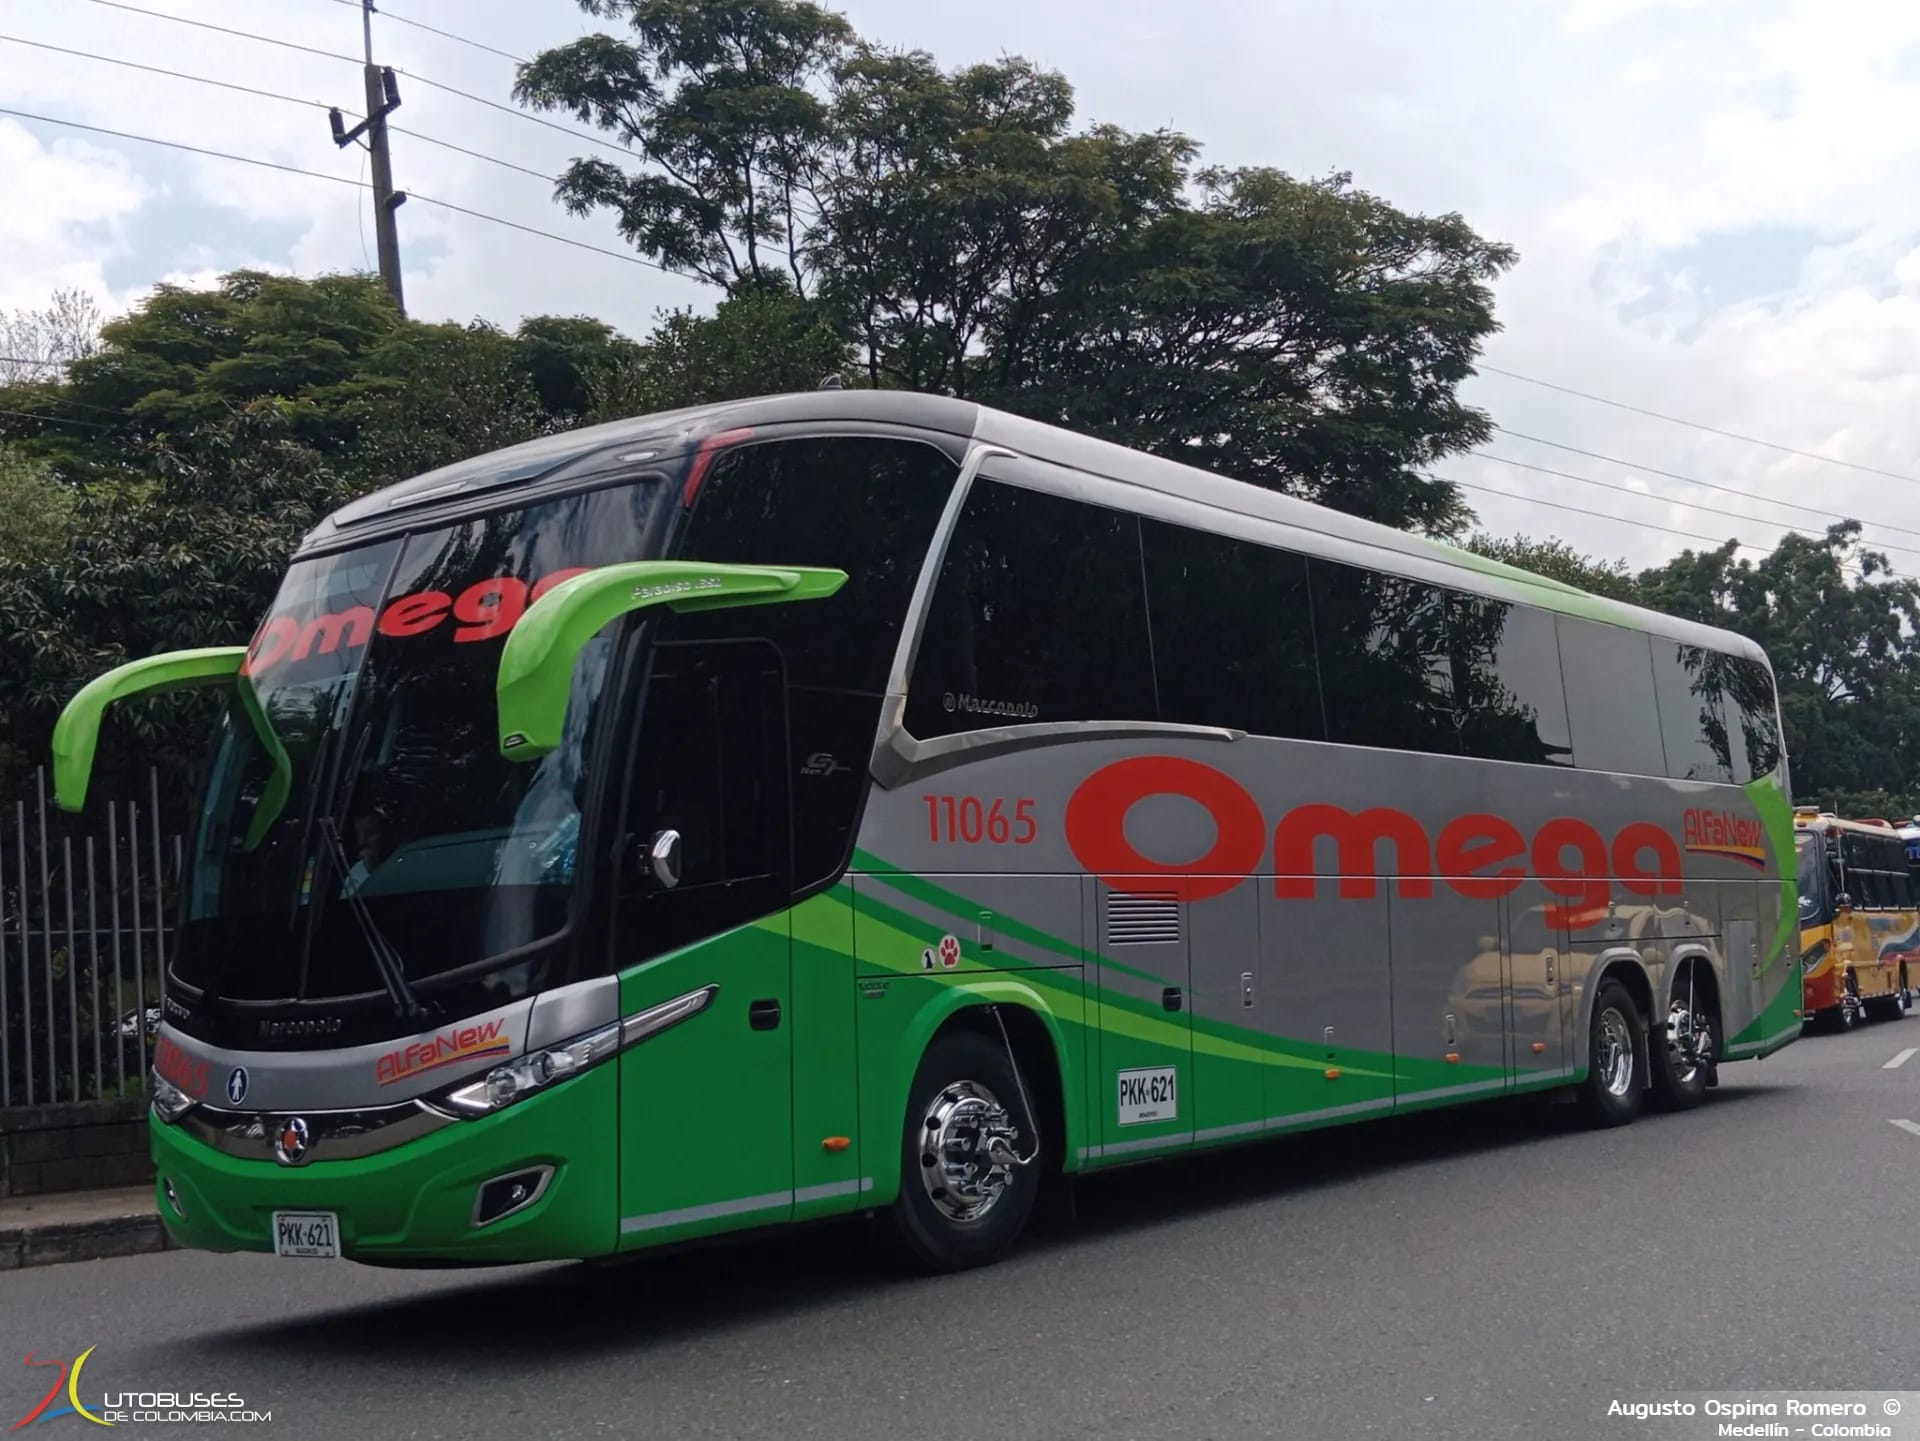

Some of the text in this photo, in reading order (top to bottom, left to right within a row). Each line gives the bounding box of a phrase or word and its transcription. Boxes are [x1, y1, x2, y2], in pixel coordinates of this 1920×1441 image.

[239, 566, 593, 677] Omeg
[923, 794, 1038, 845] 11065
[1064, 755, 1682, 931] Omega
